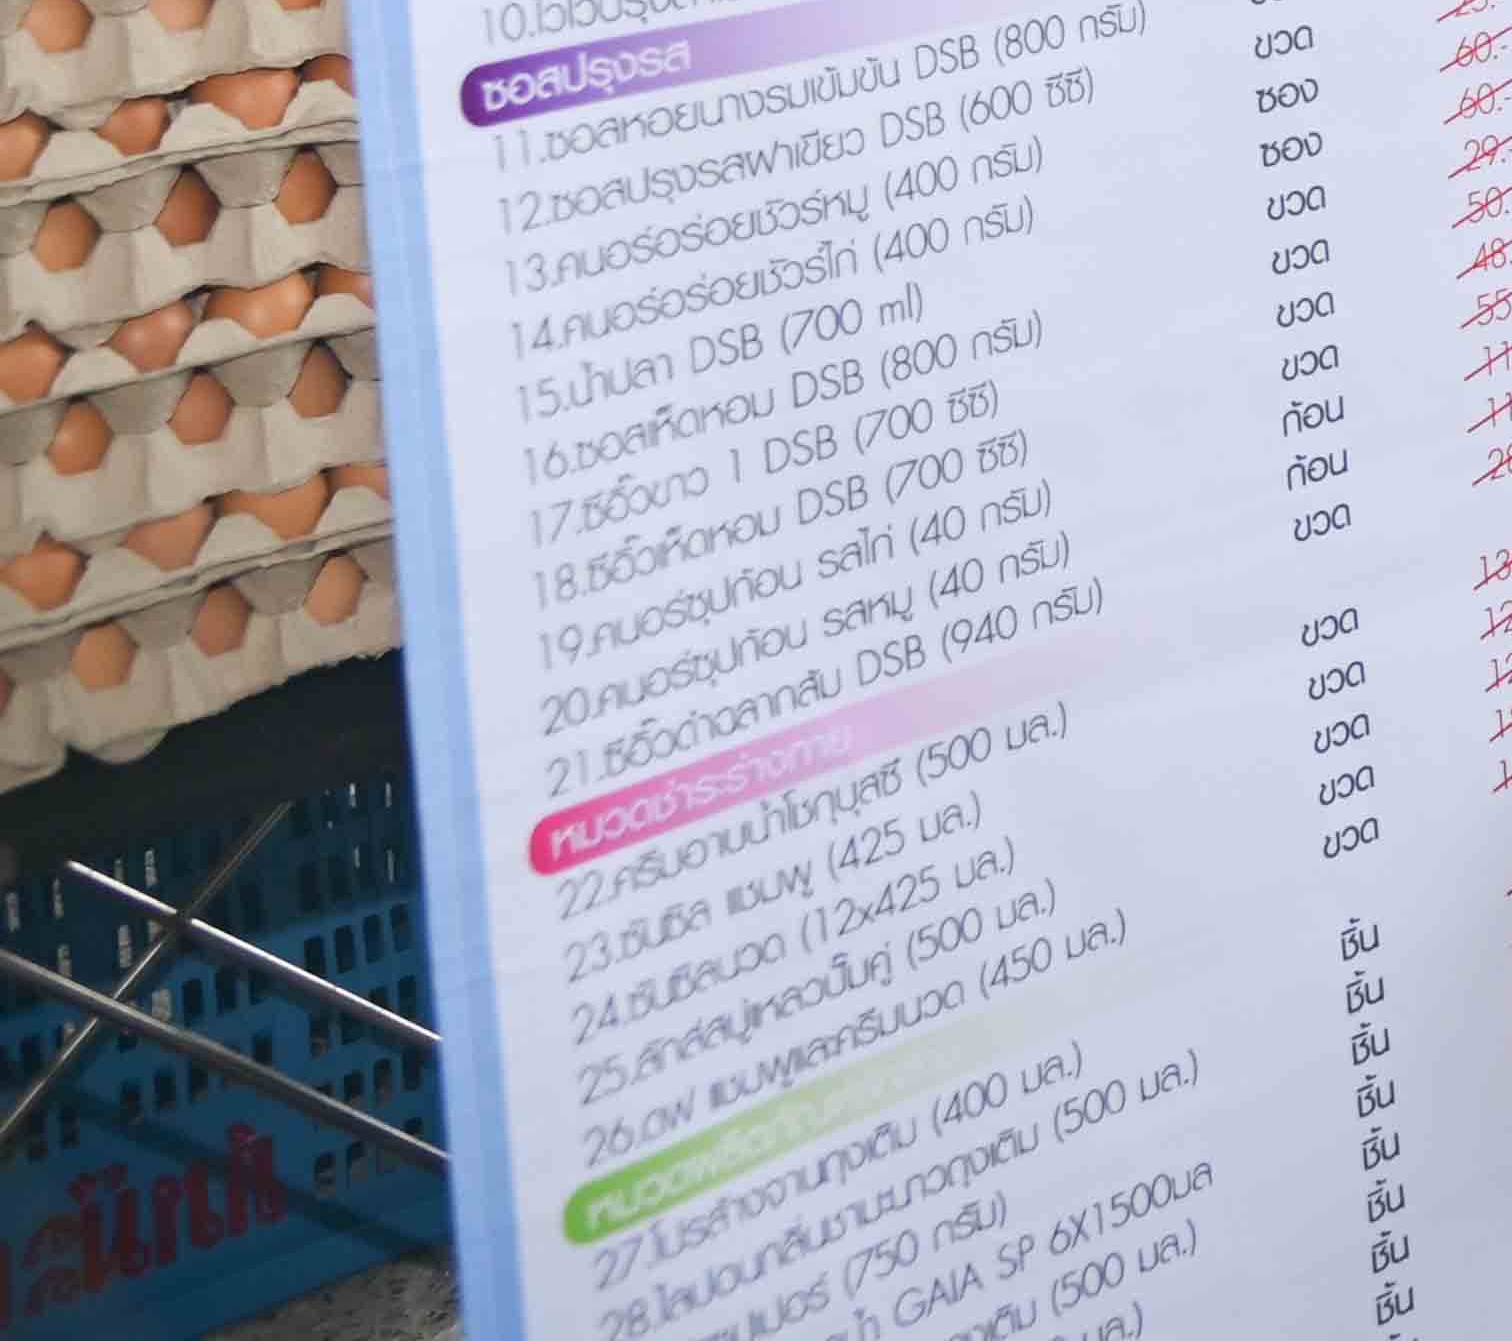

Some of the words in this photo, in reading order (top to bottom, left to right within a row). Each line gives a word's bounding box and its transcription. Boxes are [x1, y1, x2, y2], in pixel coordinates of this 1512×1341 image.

[915, 27, 980, 80] DSB
[992, 11, 1065, 67] (800
[880, 97, 946, 150] DSB
[959, 78, 1032, 133] (600
[690, 323, 763, 377] DSB
[780, 298, 863, 356] (700
[1282, 396, 1345, 435] ก้อน
[909, 499, 967, 555] (40
[979, 479, 1052, 534] กรัม)
[1340, 917, 1380, 961] ชิ้น
